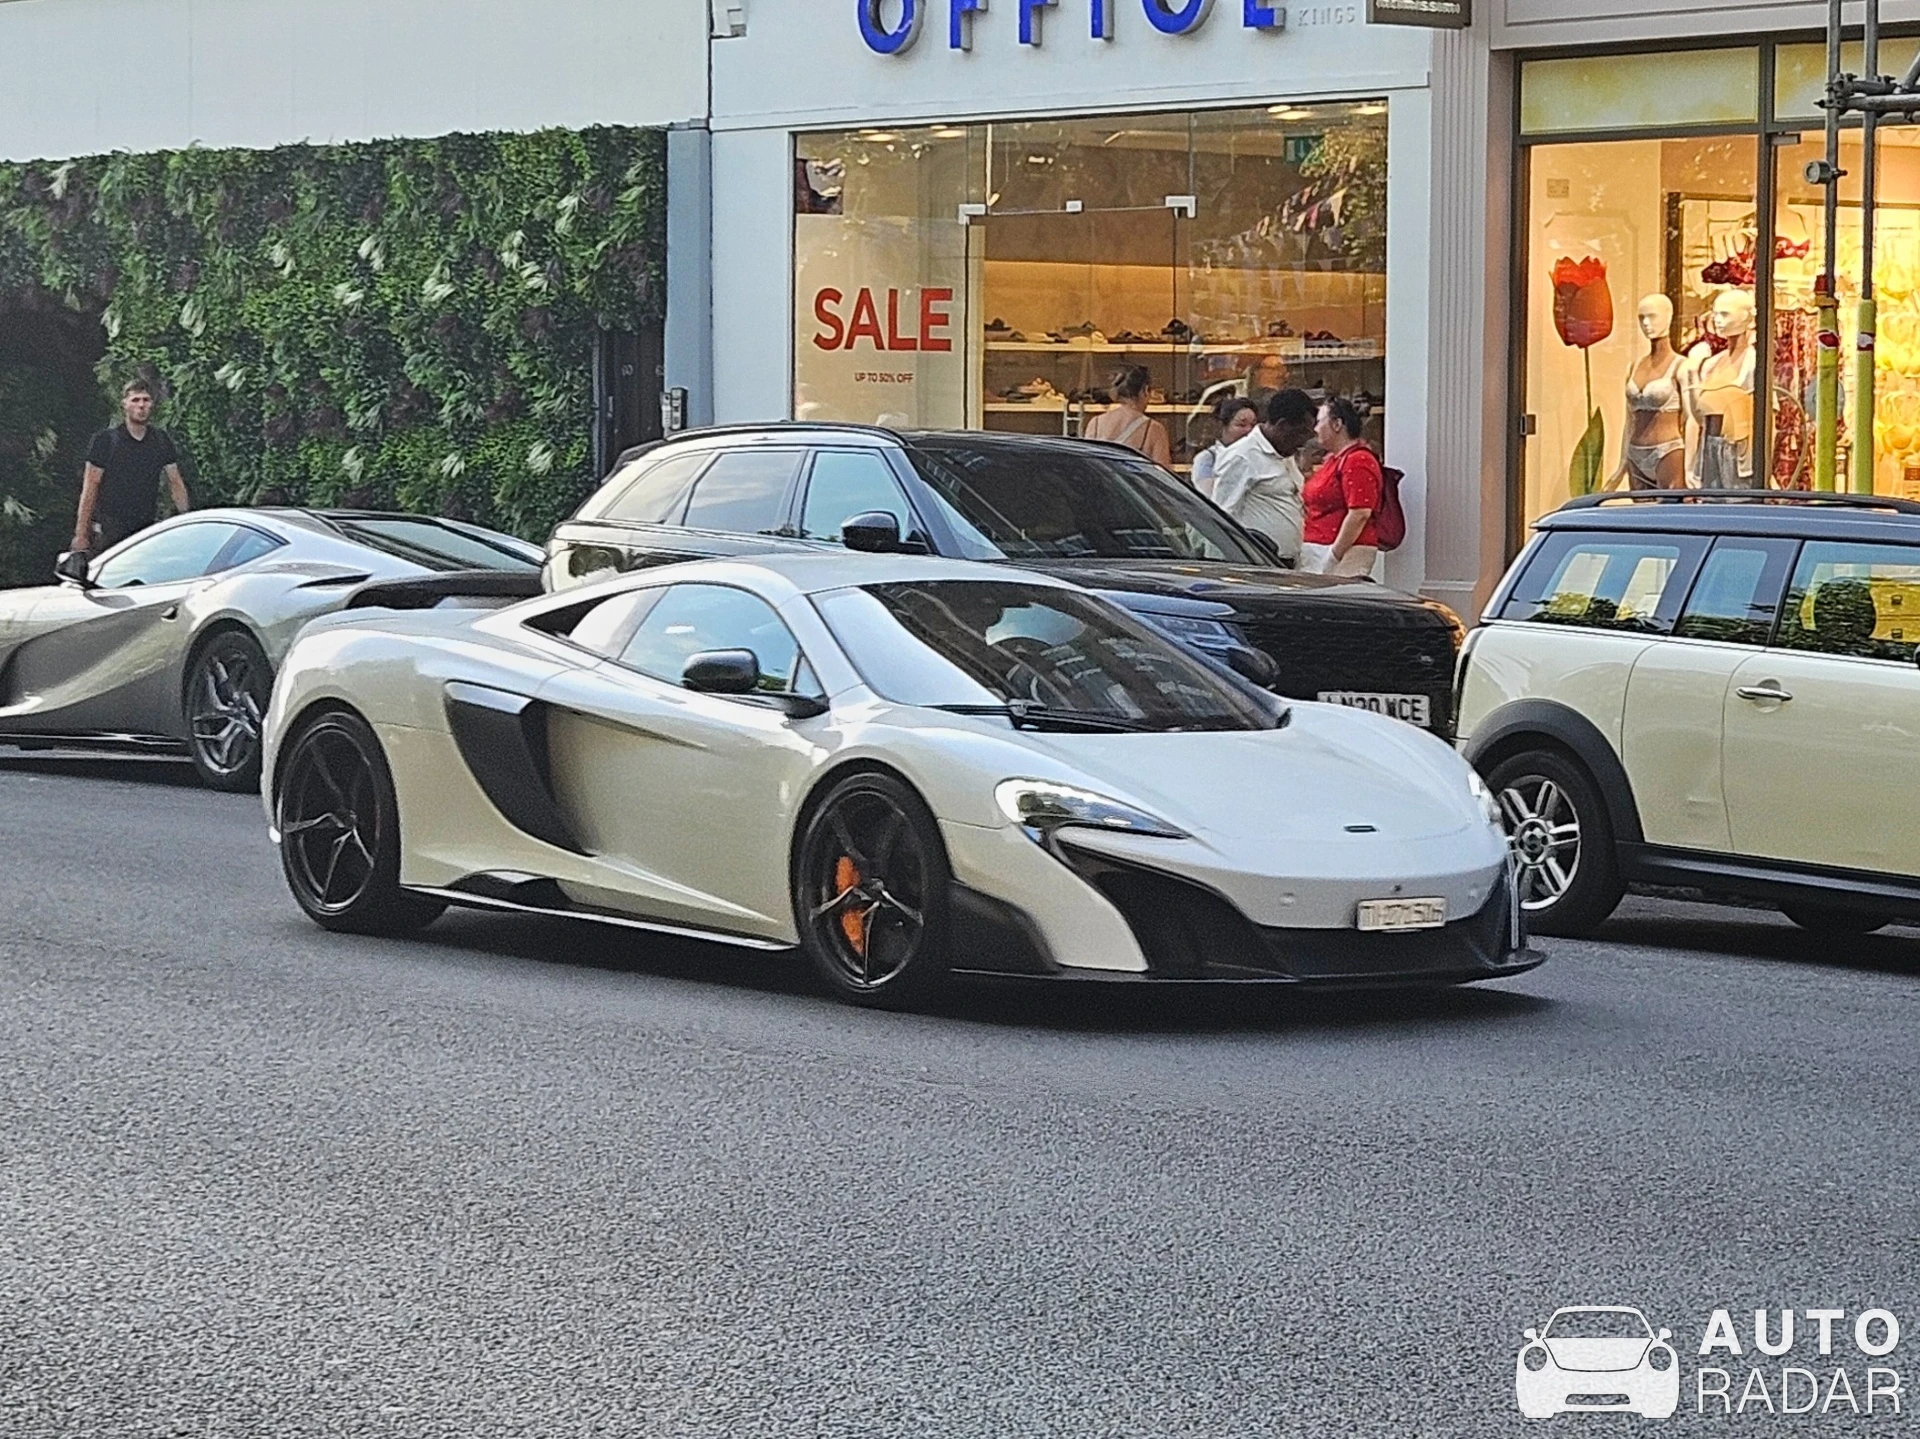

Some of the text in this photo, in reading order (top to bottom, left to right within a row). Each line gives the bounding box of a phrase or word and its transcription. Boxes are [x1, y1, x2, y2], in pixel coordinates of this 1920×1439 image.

[857, 0, 1287, 55] OFF
[813, 287, 953, 352] SALE
[855, 372, 866, 382] UP
[867, 372, 878, 383] TO
[897, 373, 914, 383] OFF
